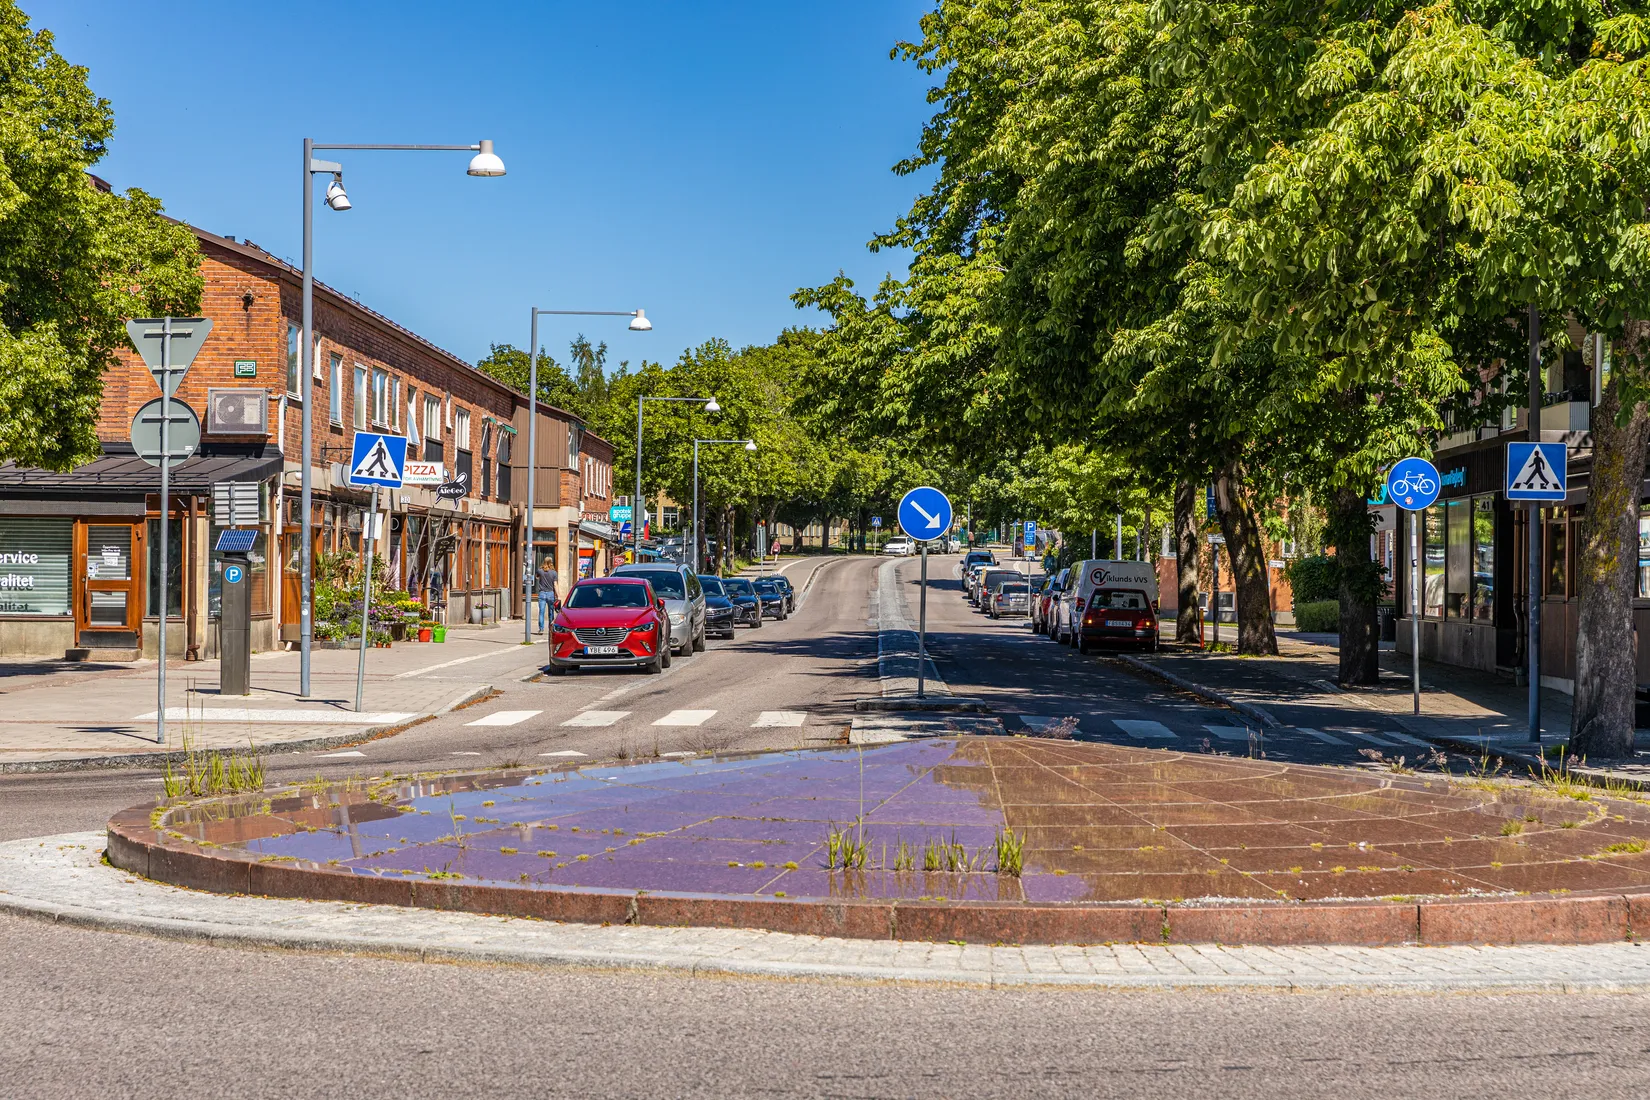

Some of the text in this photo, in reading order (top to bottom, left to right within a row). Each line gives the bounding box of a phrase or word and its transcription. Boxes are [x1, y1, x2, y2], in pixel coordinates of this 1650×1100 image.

[404, 465, 437, 476] PIZZA
[1481, 501, 1490, 510] 41
[1027, 522, 1034, 531] P
[229, 569, 239, 581] P
[1094, 570, 1132, 583] Viklunds
